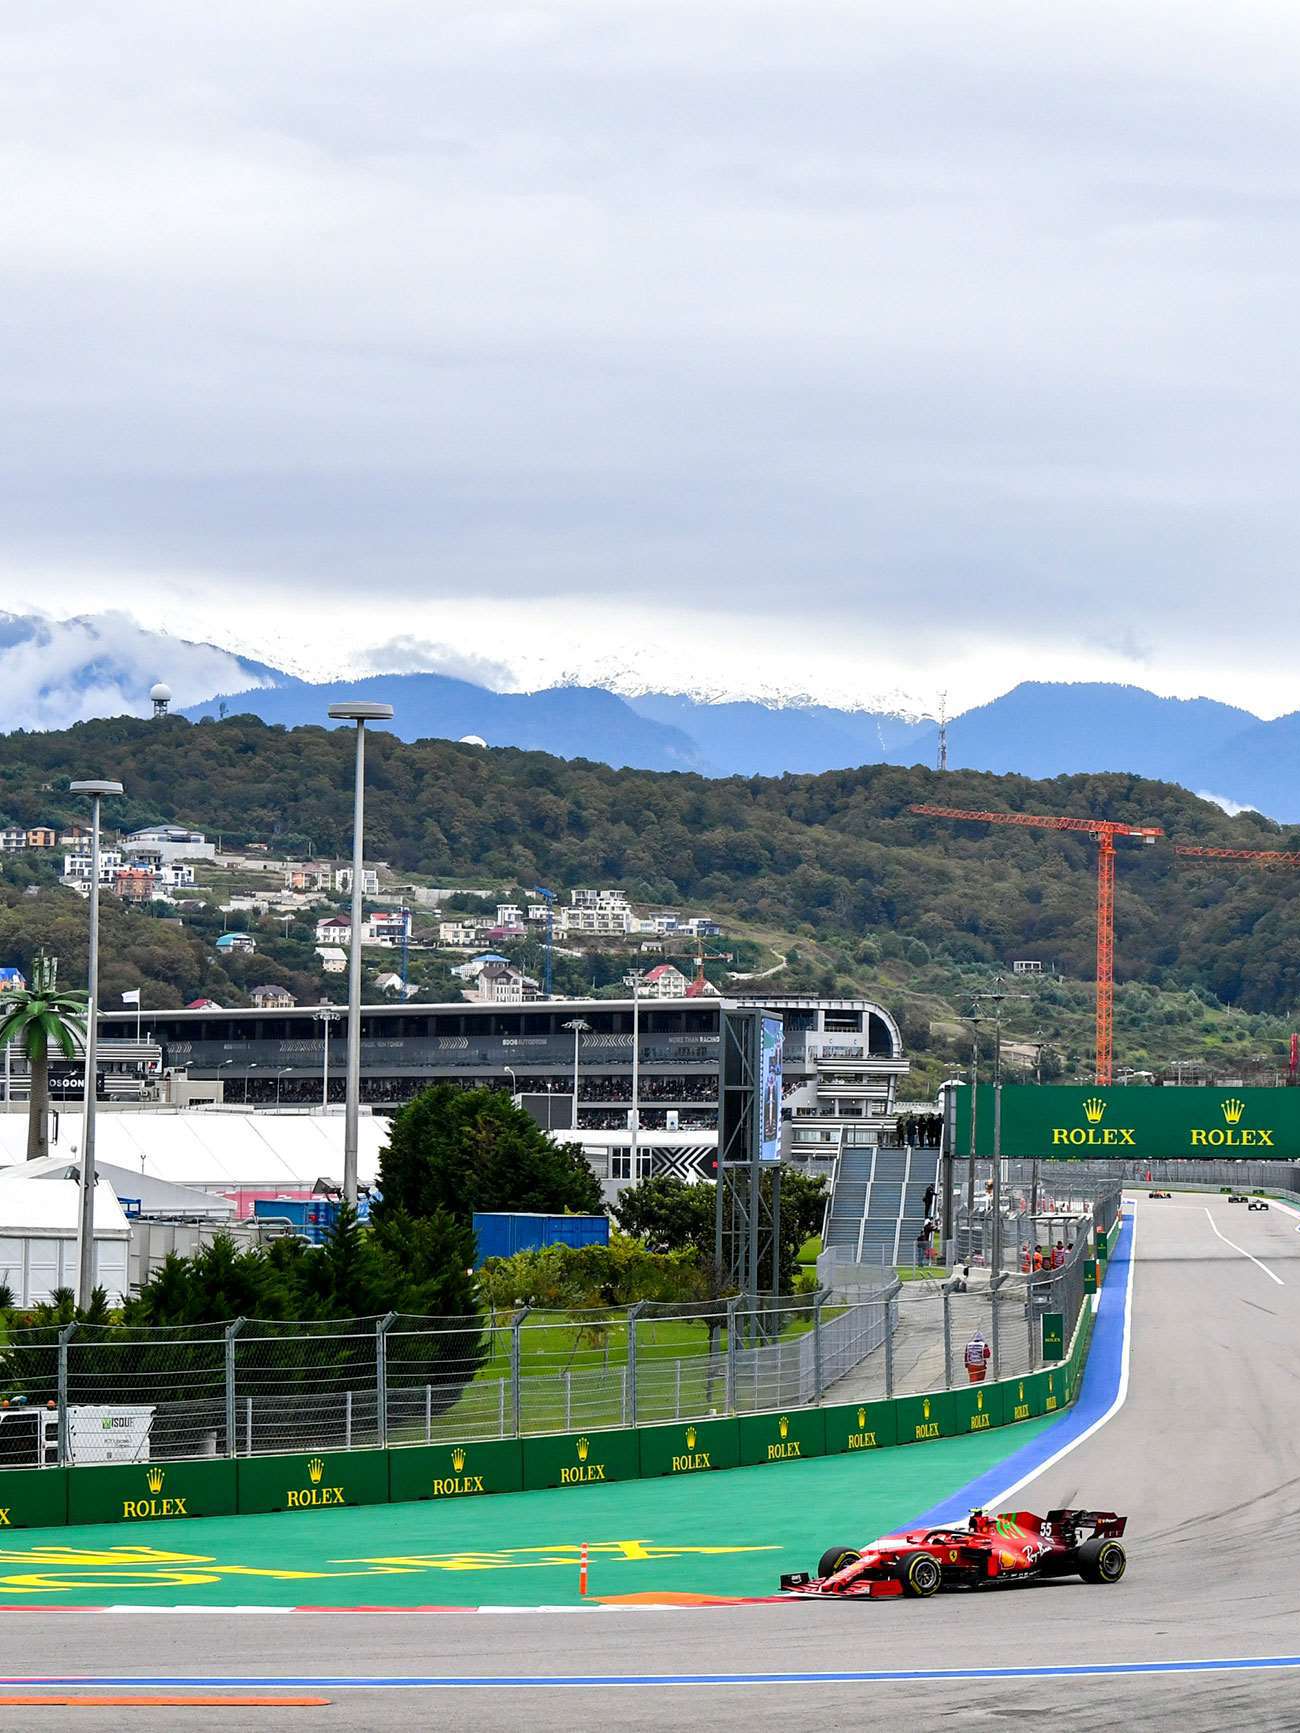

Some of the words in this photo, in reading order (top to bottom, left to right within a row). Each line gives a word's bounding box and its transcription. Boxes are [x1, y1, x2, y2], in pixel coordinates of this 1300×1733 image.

[1052, 1128, 1136, 1145] ROLEX
[1191, 1129, 1274, 1146] ROLEX
[916, 1423, 939, 1438] ROLEX
[849, 1432, 876, 1448] ROLEX
[768, 1442, 801, 1459] ROLEX
[673, 1452, 711, 1471] ROLEX
[560, 1464, 606, 1483] ROLEX
[433, 1476, 484, 1496] ROLEX
[287, 1487, 345, 1507] ROLEX
[123, 1498, 187, 1518] ROLEX
[1040, 1522, 1052, 1536] 55
[0, 1540, 783, 1593] OLEX
